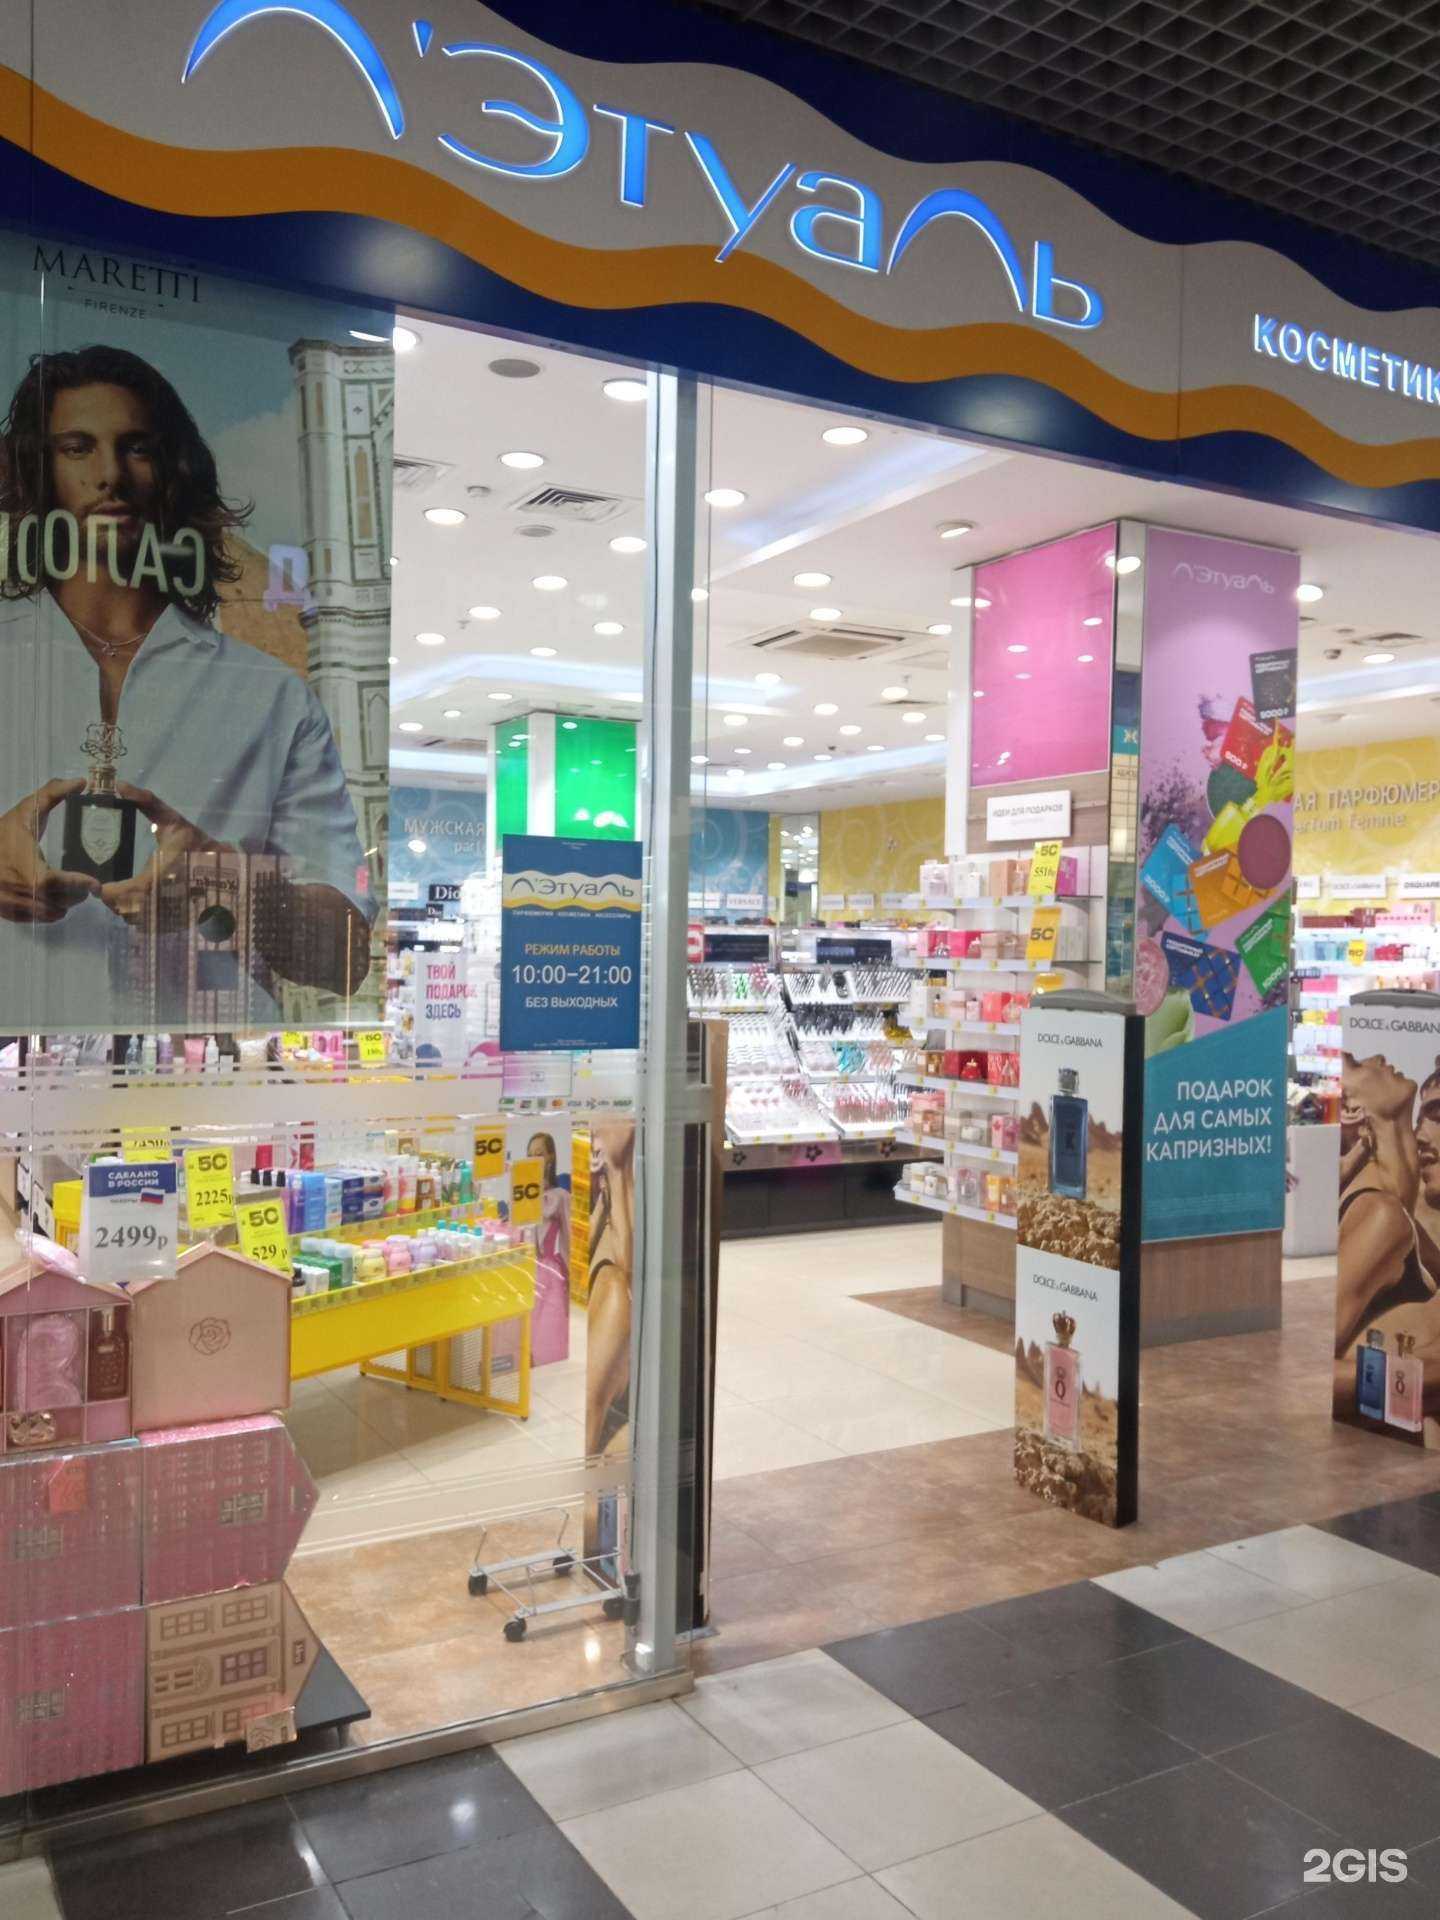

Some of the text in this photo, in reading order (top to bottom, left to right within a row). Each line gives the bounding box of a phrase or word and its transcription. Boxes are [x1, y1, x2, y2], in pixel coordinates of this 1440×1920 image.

[33, 244, 201, 303] MARETTI
[84, 298, 148, 320] FIRENZE
[404, 818, 485, 836] МУЖСКАЯ
[510, 877, 634, 900] Л'Этуаль
[525, 943, 621, 957] РЕЖИМ РАБОТЫ
[427, 961, 456, 979] ТВОЙ
[425, 1003, 461, 1020] ЗДЕСЬ
[525, 996, 618, 1009] БЕЗ ВЫХОДНЫХ
[1350, 1017, 1384, 1030] DOLCE
[1177, 1078, 1272, 1102] ПОДАРОК
[1153, 1107, 1272, 1136] ДЛЯ САМЫХ
[1146, 1134, 1272, 1162] КАПРИЗНЫХ!
[107, 1170, 159, 1181] СДЕЛАНО
[117, 1179, 159, 1187] РОССИИ
